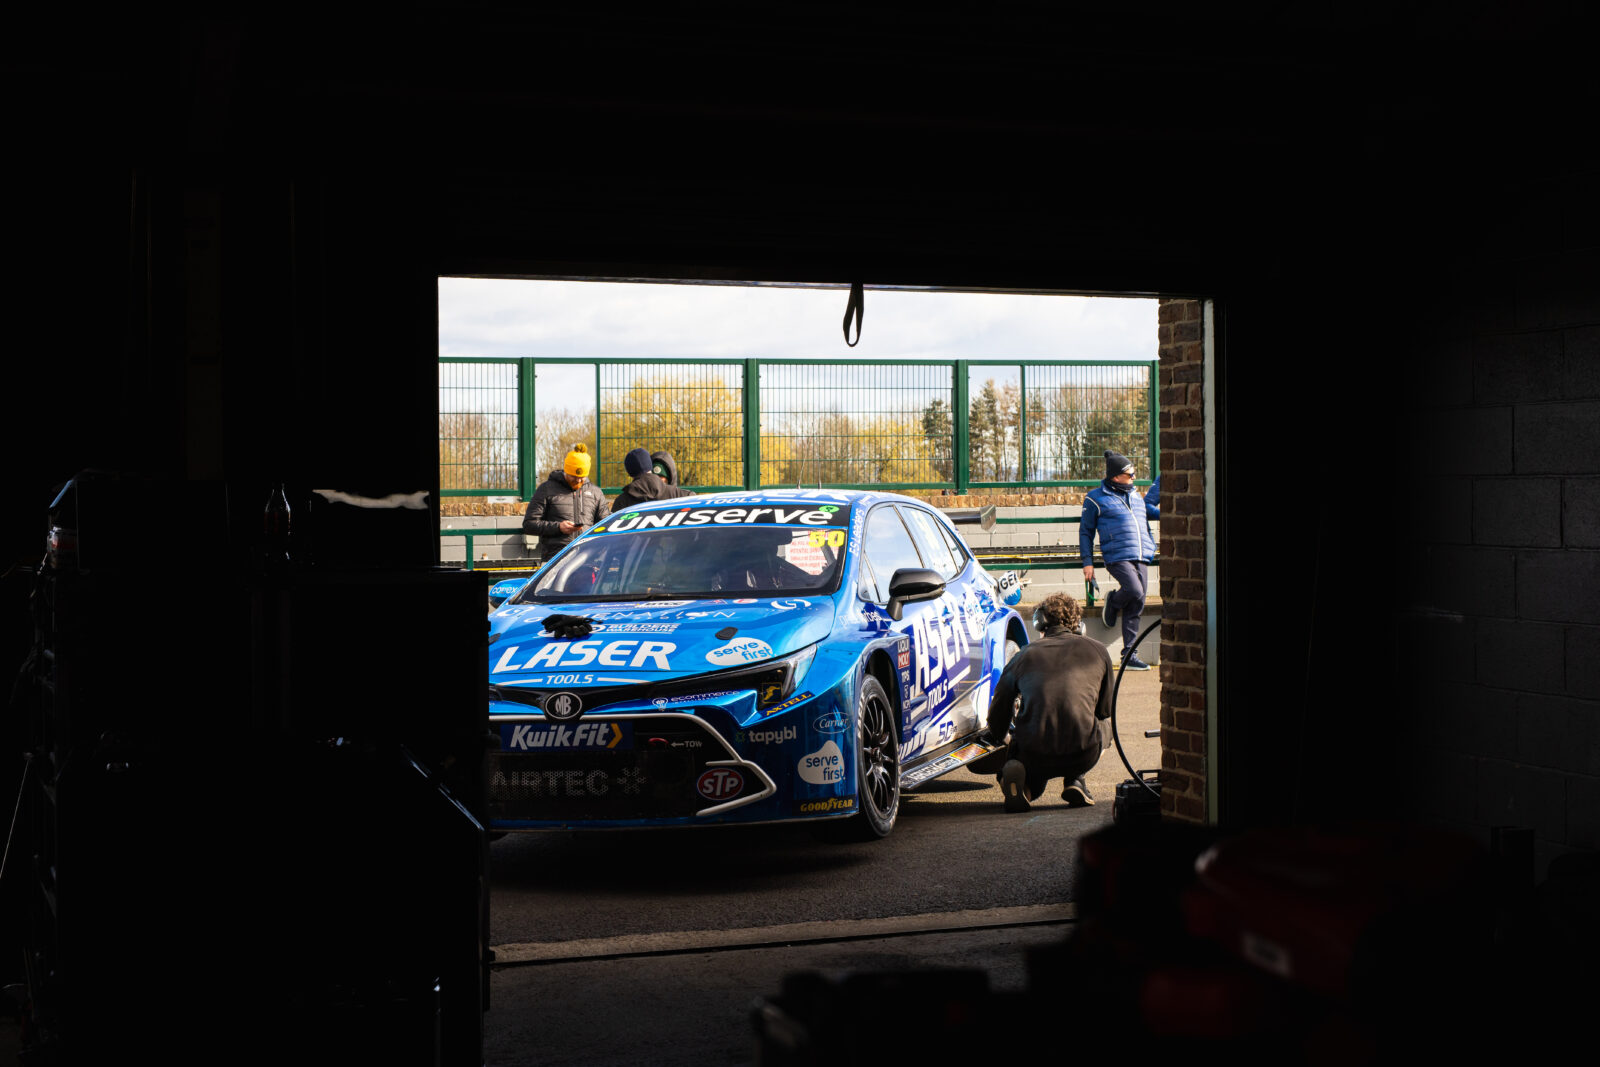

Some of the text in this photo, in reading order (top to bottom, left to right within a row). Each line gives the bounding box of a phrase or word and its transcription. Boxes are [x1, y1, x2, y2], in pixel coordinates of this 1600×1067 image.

[705, 497, 763, 505] TOOLS
[808, 530, 846, 549] 50
[491, 640, 677, 674] LASER
[713, 642, 758, 657] serve
[545, 674, 594, 685] TOOLS
[671, 690, 740, 702] ecommerce
[928, 678, 948, 711] TOOLS
[766, 693, 811, 715] AXTELL
[819, 716, 849, 729] Carrier
[749, 725, 796, 744] tapybl
[684, 740, 703, 748] TOW
[806, 755, 838, 768] serve
[489, 769, 609, 797] AIRTEC
[703, 771, 740, 796] STP
[800, 797, 853, 812] GOODYEAR
